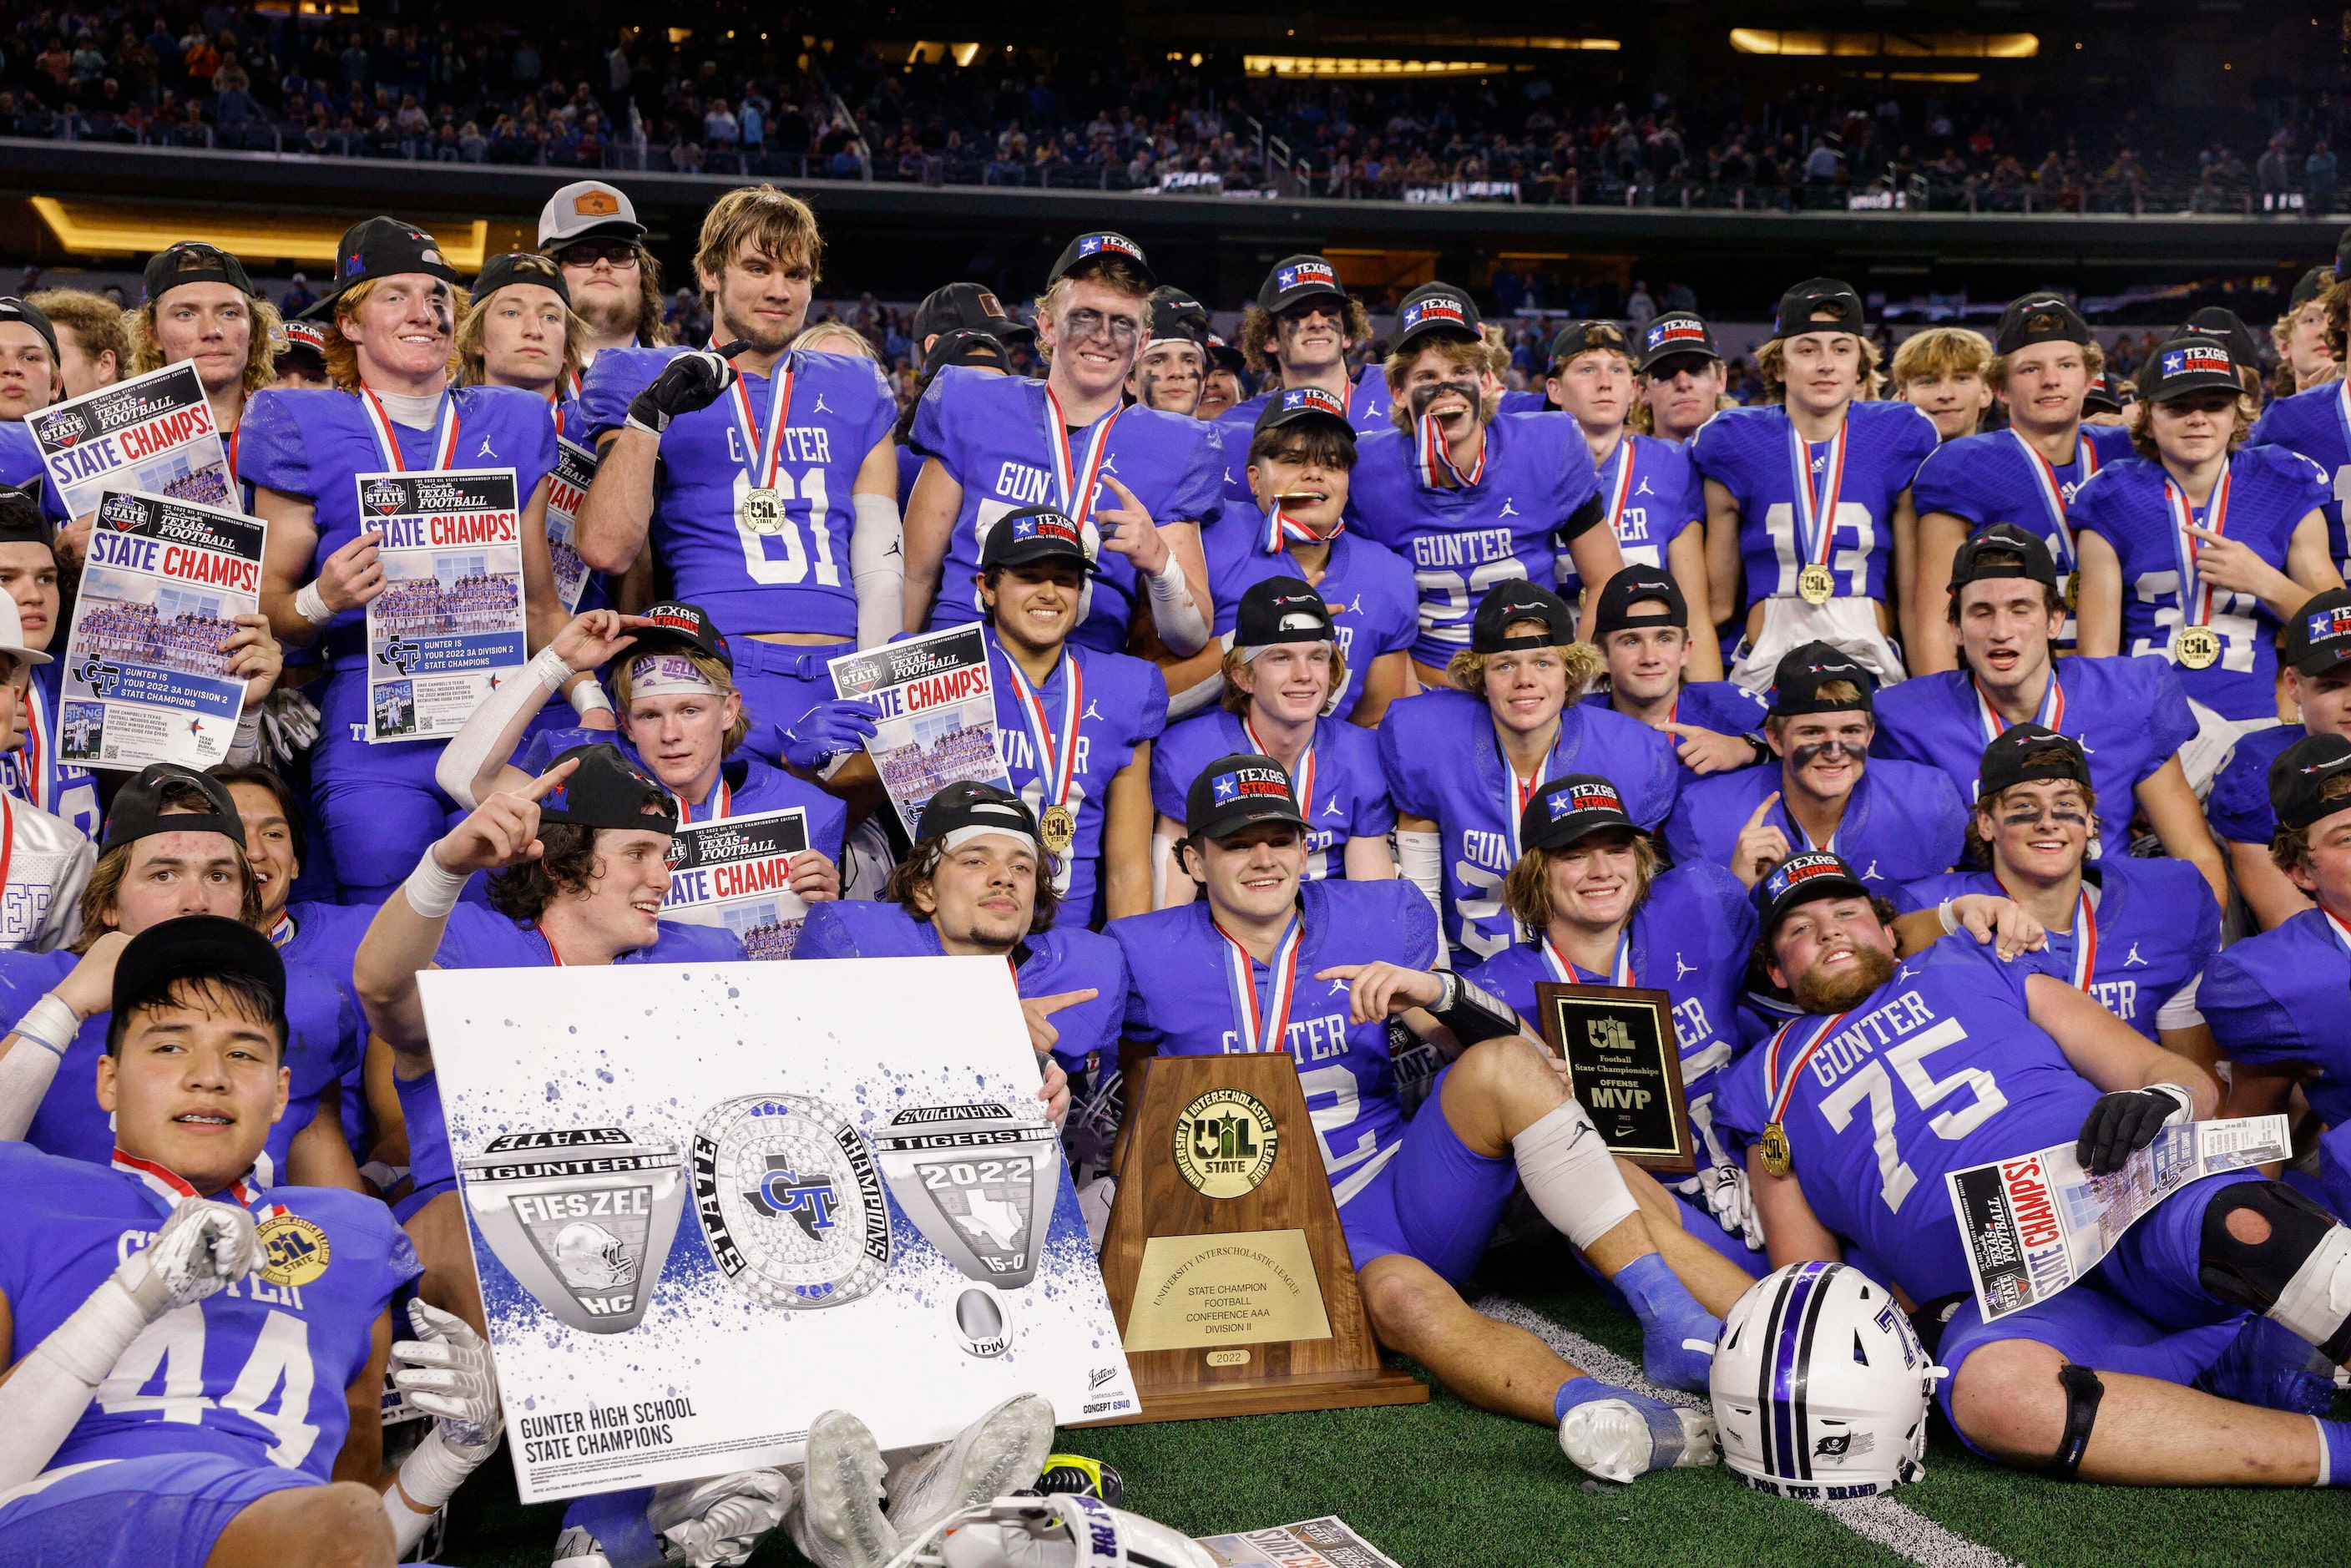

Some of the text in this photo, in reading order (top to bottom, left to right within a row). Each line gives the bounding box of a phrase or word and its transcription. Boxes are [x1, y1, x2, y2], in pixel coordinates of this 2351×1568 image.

[1295, 263, 1332, 278] TEXAS
[1419, 299, 1463, 313] TEXAS
[1663, 319, 1702, 331] TEXAS
[2184, 346, 2229, 362] TEXAS
[2185, 359, 2230, 373] STRONG
[94, 400, 137, 418] TEXAS
[1304, 389, 1342, 411] TEXAS
[101, 396, 174, 429] FOOTBALL
[42, 417, 85, 440] STATE
[51, 404, 214, 483] STATE CHAMPS!
[726, 427, 832, 463] GTER
[366, 492, 405, 503] STATE
[417, 488, 455, 498] TEXAS
[418, 495, 487, 509] FOOTBALL
[104, 506, 146, 522] STATE
[751, 500, 777, 518] UIL
[159, 514, 205, 531] TEXAS
[211, 514, 243, 526] CHAMPIONSHIP
[244, 521, 260, 531] EDITION
[431, 513, 517, 546] CHAMPS!
[733, 468, 842, 587] 61
[1035, 513, 1076, 534] TEXAS
[158, 524, 235, 550] FOOTBALL
[1413, 529, 1514, 567] GUNTER
[91, 532, 259, 593] STATE CHAMPS!
[649, 606, 700, 626] TEXAS
[425, 640, 453, 649] GUNTER
[425, 650, 444, 660] YOUR
[446, 649, 465, 658] 2022
[467, 648, 477, 657] 3A
[478, 646, 508, 656] DIVISION
[425, 658, 490, 669] STATE CHAMPIONS
[891, 653, 928, 670] TEXAS
[894, 655, 959, 680] FOOTBALL
[125, 668, 168, 680] GUNTER IS
[842, 668, 879, 685] STATE
[124, 678, 144, 689] YOUR
[147, 682, 168, 692] 2022
[170, 685, 182, 695] 3A
[184, 687, 220, 702] DIVISION
[908, 665, 989, 711] CHAMPS!
[121, 689, 196, 708] STATE CHAMPIONS
[1236, 768, 1287, 785] TEXAS
[1240, 781, 1289, 798] STRONG
[1570, 784, 1617, 799] TEXAS
[745, 819, 780, 828] CHAMPIONSHIP
[1048, 817, 1068, 836] UIL
[698, 836, 741, 851] TEXAS
[700, 840, 776, 862] FOOTBALL
[1784, 856, 1838, 874] TEXAS
[1788, 865, 1843, 885] STRONG
[1587, 1015, 1636, 1050] UIL
[1809, 990, 1935, 1088] GUNTER
[1575, 1063, 1659, 1076] State Championships
[1600, 1055, 1632, 1064] Football
[1600, 1079, 1639, 1088] OFFENSE
[1590, 1087, 1651, 1110] MVP
[899, 1105, 1013, 1125] CHAMPIONS
[1818, 1016, 2008, 1215] 75
[493, 1128, 628, 1151] STATE
[902, 1131, 1015, 1148] TIGERS
[1175, 1090, 1278, 1190] UNIVERSITY INTERSCHOLASTIC LEAGUE
[1194, 1113, 1257, 1159] UIL
[493, 1158, 635, 1180] GUNTER
[918, 1161, 1032, 1190] 2022
[1205, 1161, 1246, 1174] STATE
[761, 1169, 836, 1230] GT
[836, 1127, 887, 1262] CHAMPIONS
[513, 1188, 650, 1224] FIESZEL
[695, 1135, 746, 1277] STATE
[1987, 1196, 2016, 1262] FOOTBALL
[2003, 1156, 2070, 1298] STATE CHAMPS!
[316, 1233, 330, 1265] LEAGUE
[1985, 1232, 2004, 1267] TEXAS
[284, 1254, 314, 1272] STATE
[980, 1253, 1025, 1272] 15-0
[1154, 1246, 1302, 1308] UNIVERSITY INTERSCHOLASTIC LEAGUE
[1188, 1282, 1267, 1297] STATE CHAMPION
[2002, 1274, 2017, 1311] STATE
[578, 1295, 635, 1315] HC
[1205, 1297, 1252, 1308] FOOTBALL
[1186, 1308, 1271, 1323] CONFERENCE AAA
[1205, 1323, 1252, 1335] DIVISION II
[969, 1338, 1004, 1354] TPW
[1216, 1353, 1241, 1363] 2022
[96, 1302, 320, 1469] 44
[1088, 1365, 1117, 1392] Jostens
[1091, 1390, 1125, 1402] jostens.com
[1083, 1399, 1130, 1414] CONCEPT 6940
[520, 1397, 696, 1439] GUNTER HIGH SCHOOL
[524, 1437, 573, 1464] STATE
[575, 1423, 673, 1456] CHAMPIONS
[1755, 1478, 1878, 1500] FOR THE BRAND
[1246, 1530, 1311, 1558] STATE
[1305, 1525, 1336, 1545] STATE
